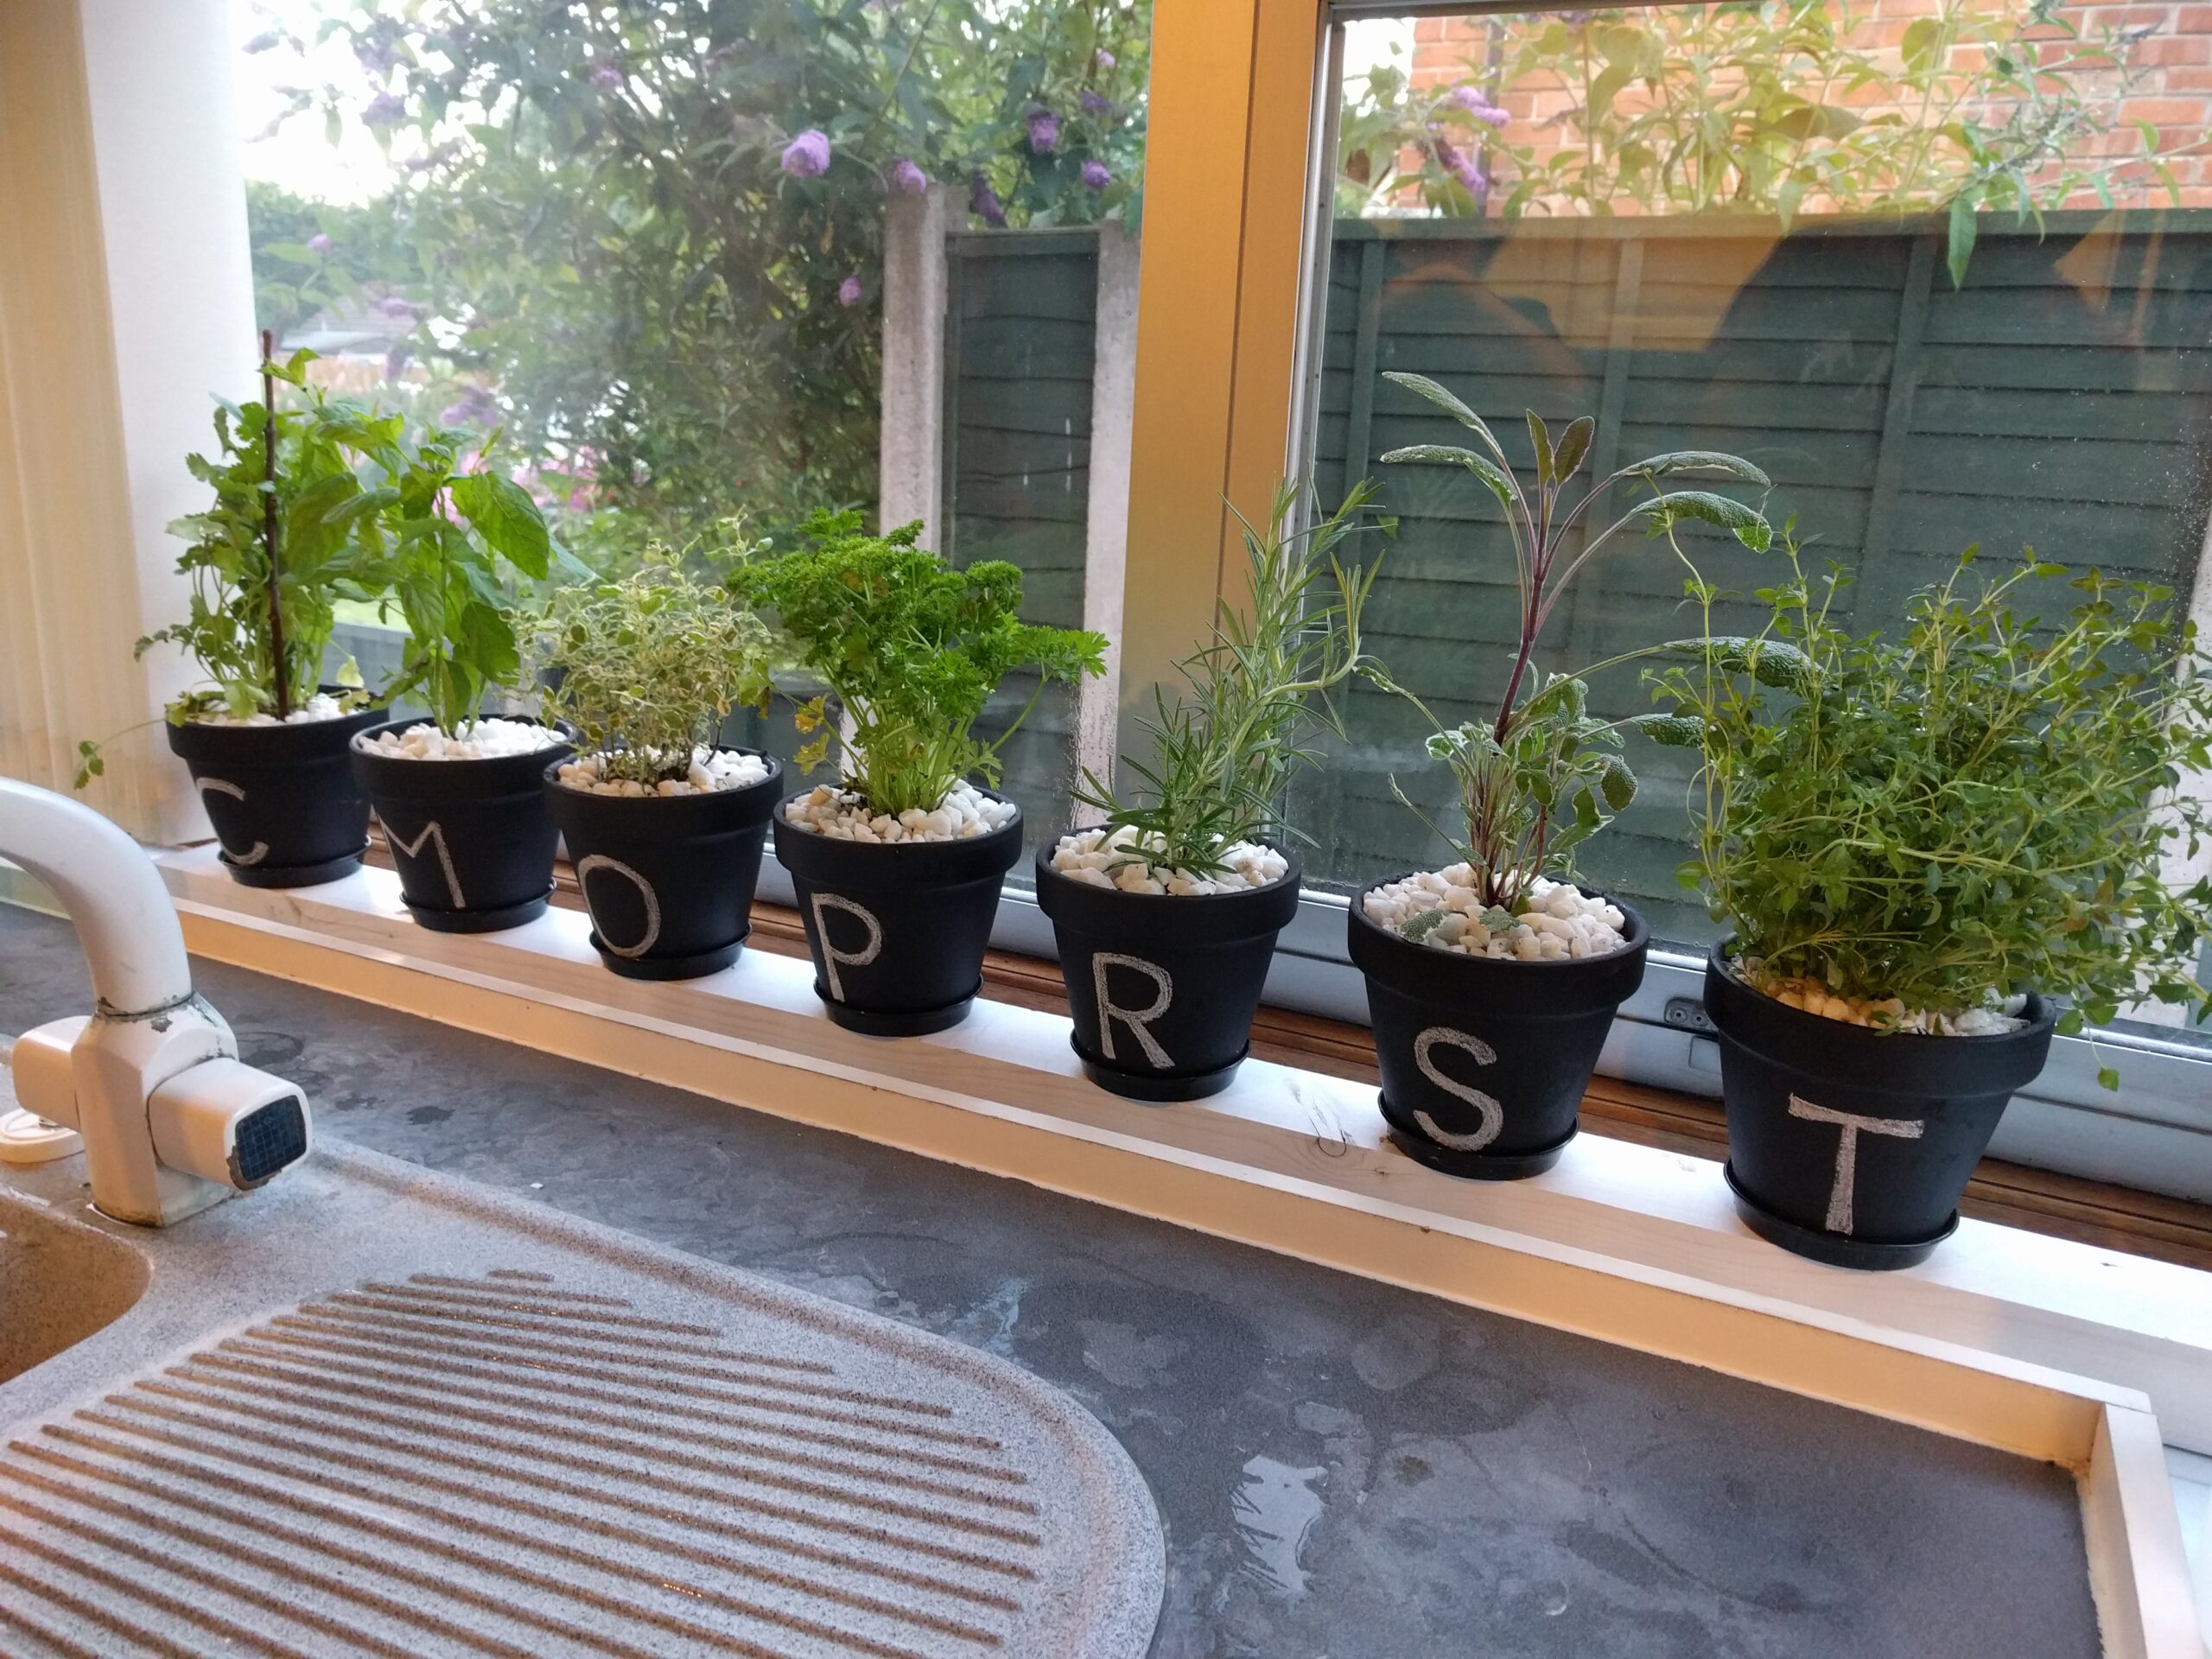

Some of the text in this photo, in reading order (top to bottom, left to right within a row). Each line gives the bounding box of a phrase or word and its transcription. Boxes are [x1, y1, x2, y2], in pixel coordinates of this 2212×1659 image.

[195, 777, 270, 865] C
[378, 810, 467, 909] M
[577, 854, 662, 958] O
[810, 893, 885, 1002] P
[1091, 950, 1176, 1071] R
[1412, 1026, 1504, 1152] S
[1787, 1091, 1926, 1236] T
